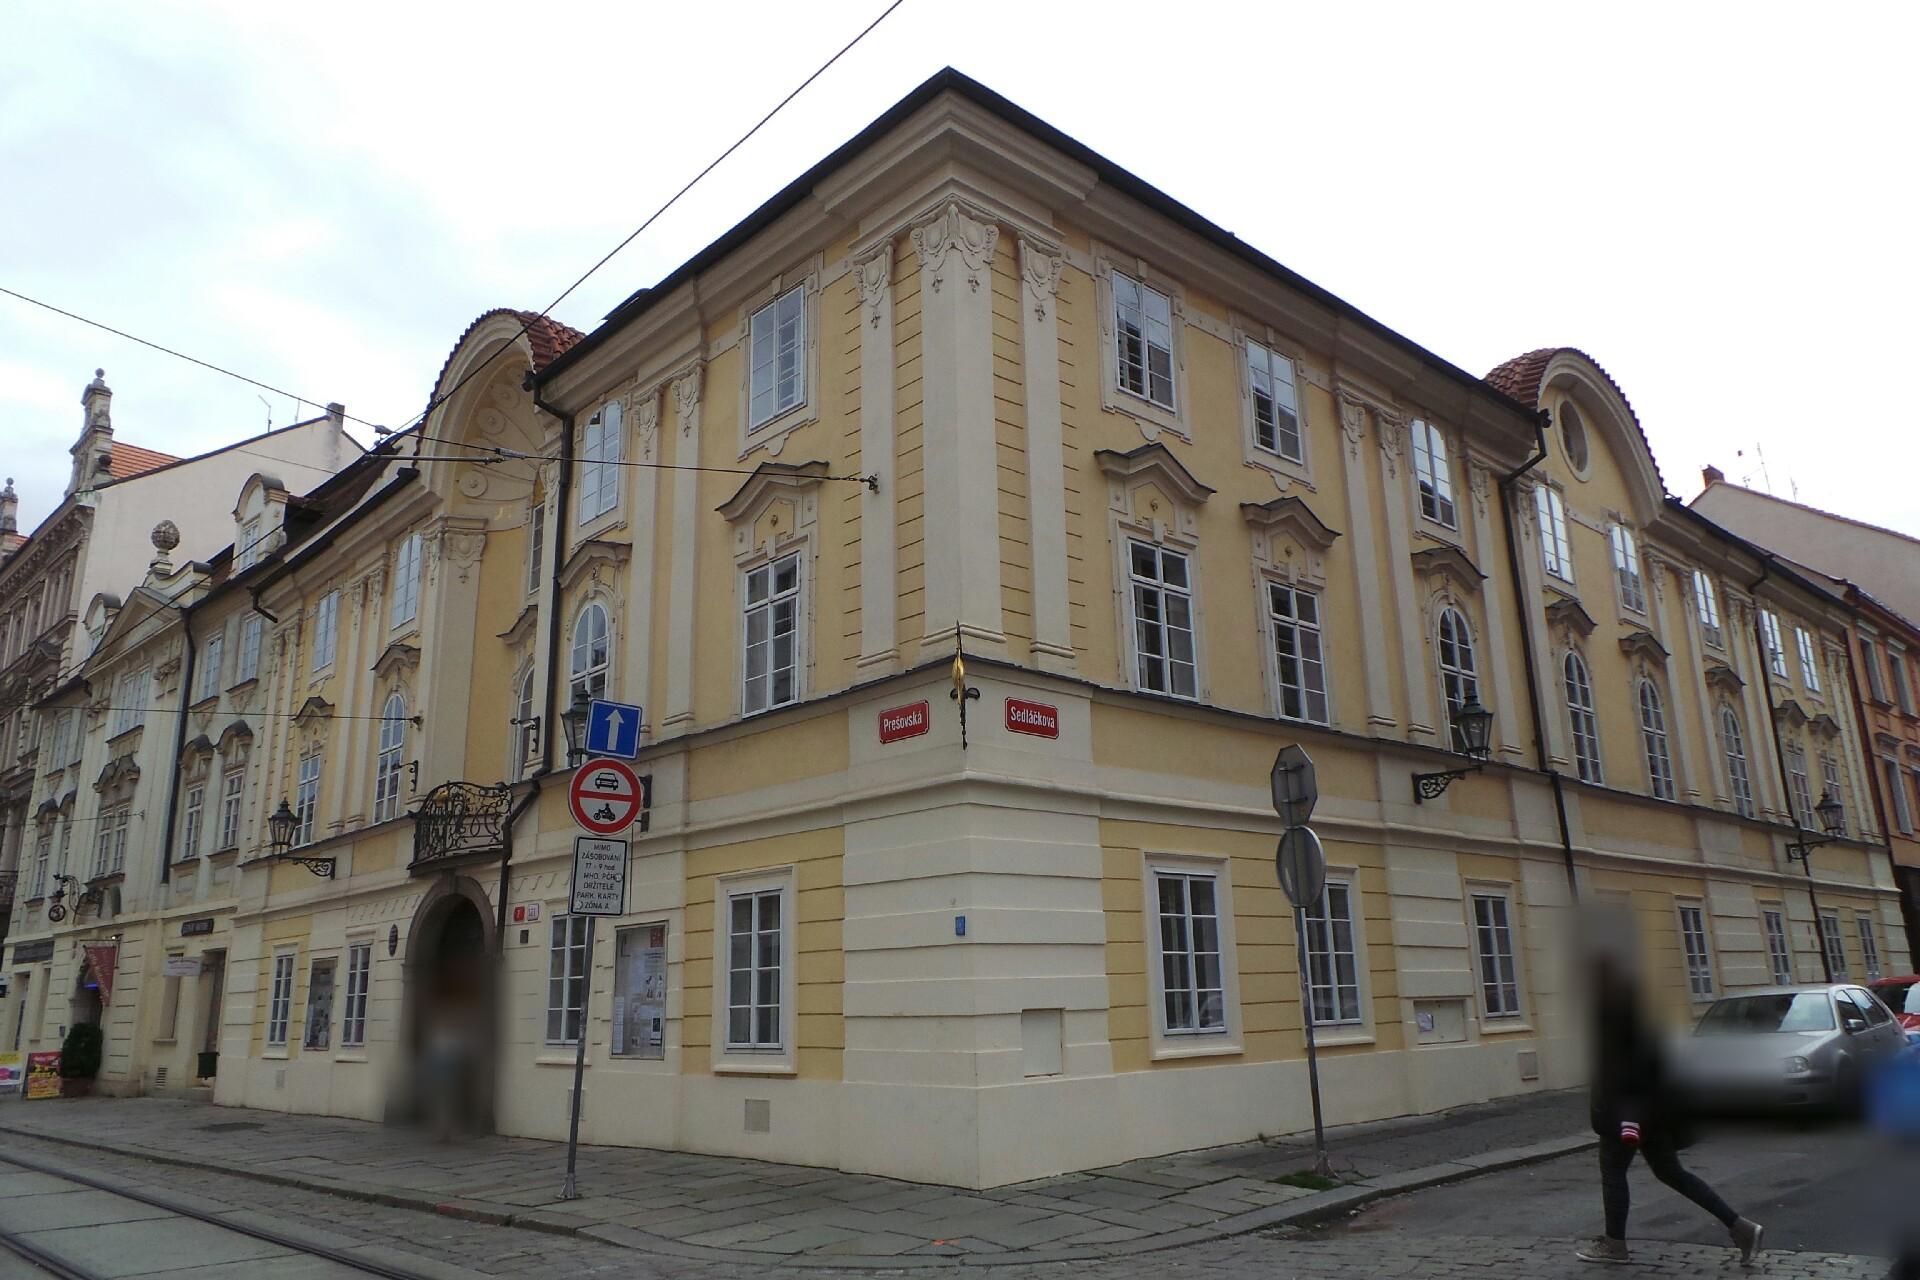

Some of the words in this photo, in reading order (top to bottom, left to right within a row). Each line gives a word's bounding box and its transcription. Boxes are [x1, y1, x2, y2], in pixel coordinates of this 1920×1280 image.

[883, 710, 922, 733] Prešovská
[1010, 705, 1055, 728] Sedláčkova
[582, 850, 621, 861] ZÁSOBOVÁNÍ
[583, 881, 615, 890] DRŽITELE
[597, 892, 620, 900] KARTY
[584, 900, 602, 909] ZÓNA
